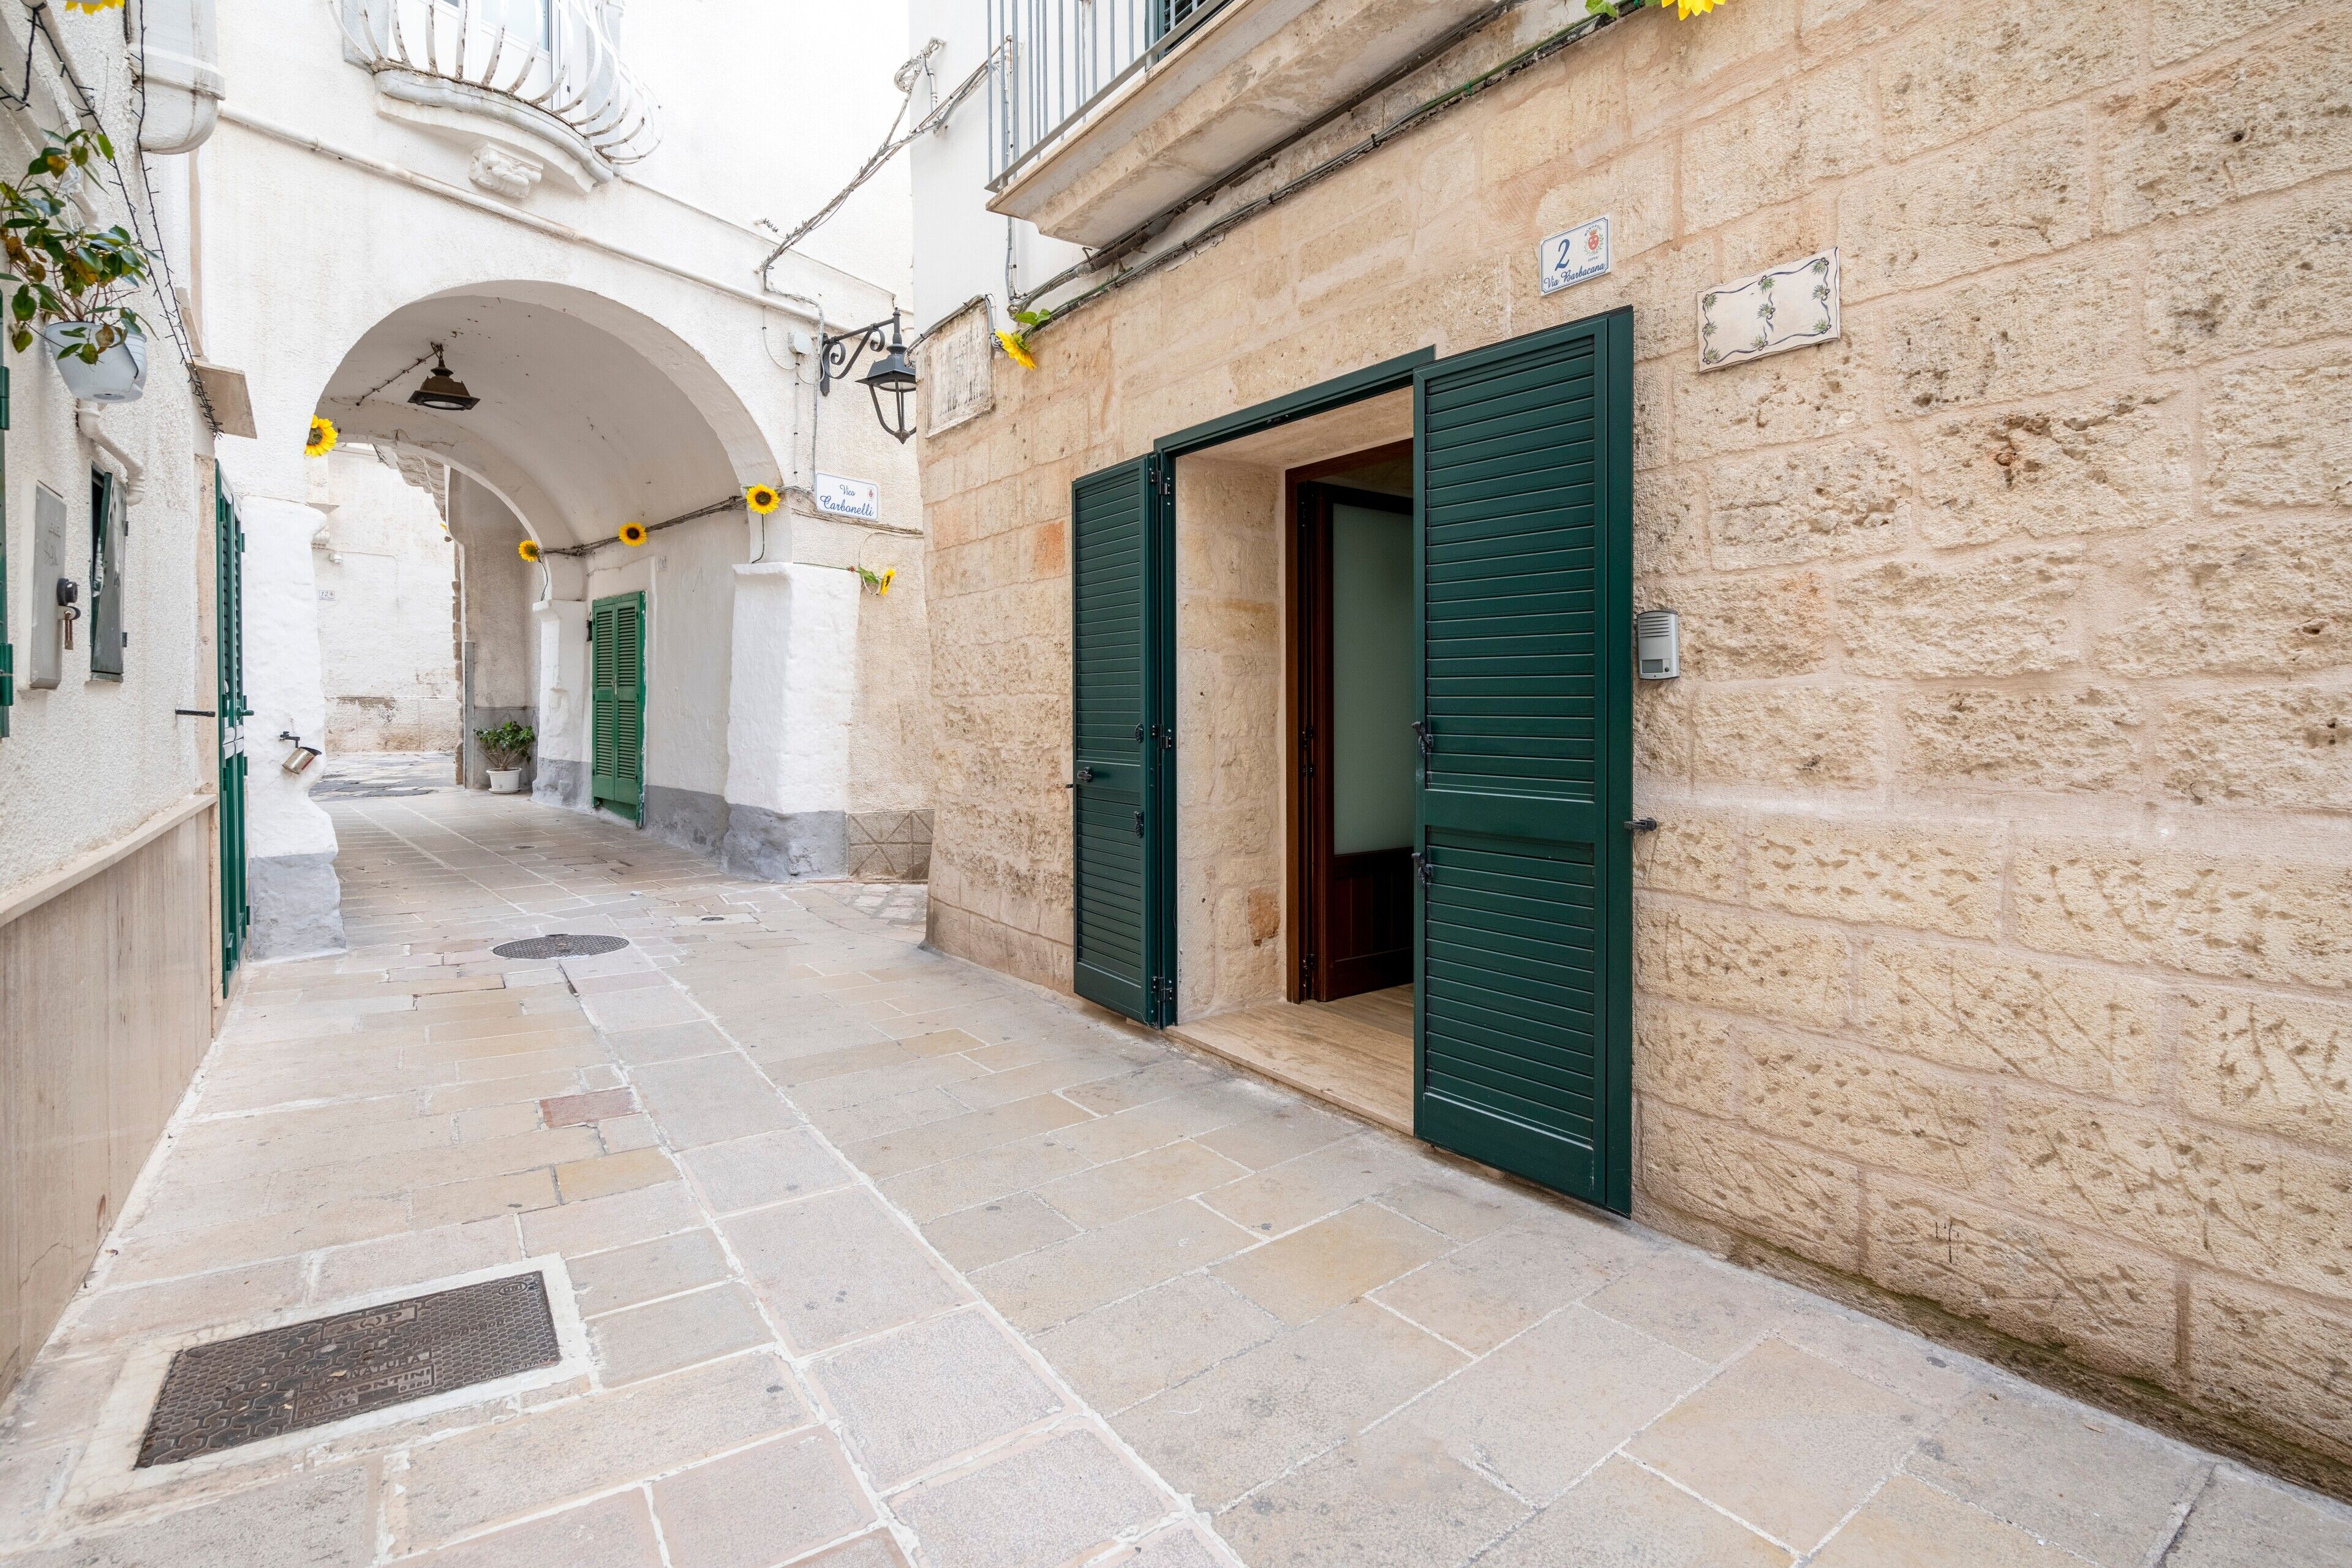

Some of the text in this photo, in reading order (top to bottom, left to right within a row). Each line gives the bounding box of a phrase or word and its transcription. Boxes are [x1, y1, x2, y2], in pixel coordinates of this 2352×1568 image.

[1555, 238, 1570, 271] 2
[1544, 263, 1605, 289] Via Barbacana
[839, 484, 856, 497] Vico
[820, 495, 874, 516] Carbonelli
[337, 1368, 430, 1399] MONTINI
